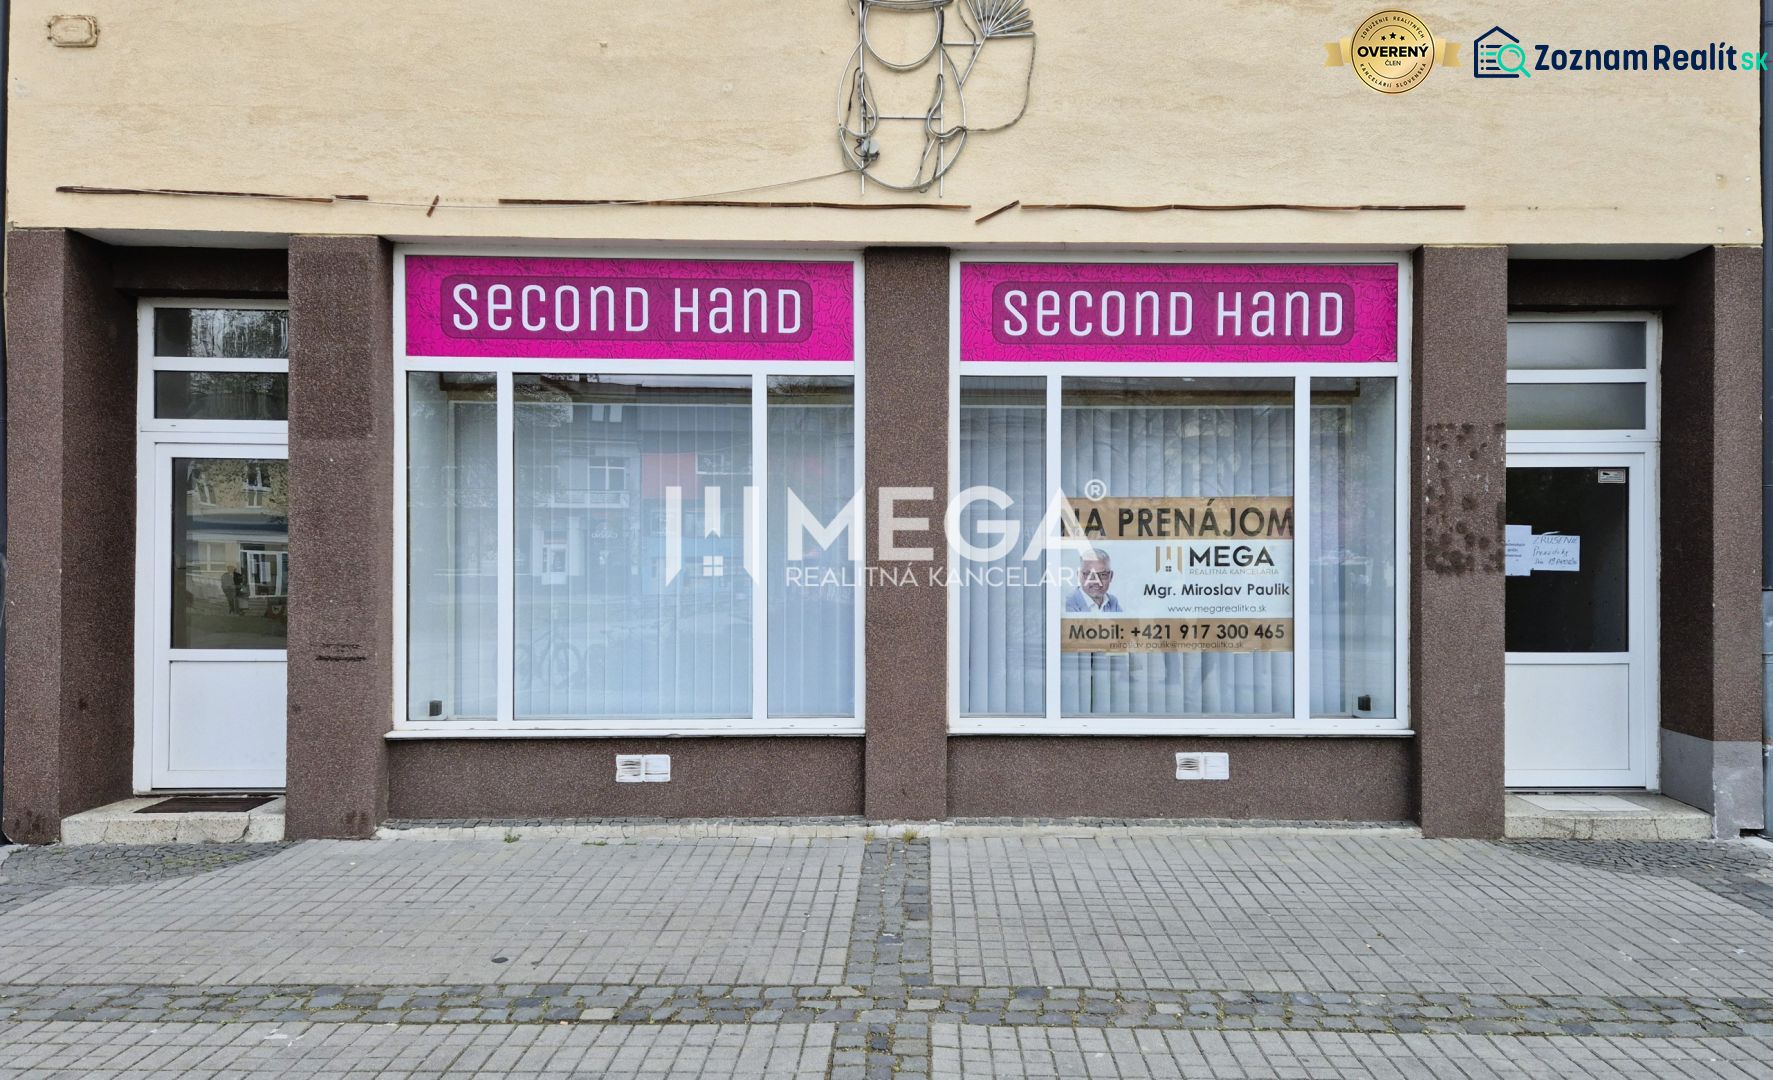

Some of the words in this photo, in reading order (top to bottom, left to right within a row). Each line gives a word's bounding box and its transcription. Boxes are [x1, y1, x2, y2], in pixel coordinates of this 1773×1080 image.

[1060, 507, 1107, 538] NA
[1118, 498, 1294, 538] PRENÁJOM
[1189, 545, 1275, 568] MEGA
[1143, 584, 1176, 599] Mgr.
[1181, 583, 1242, 596] Miroslav
[1247, 583, 1290, 596] Paulik
[1168, 604, 1267, 614] www.megarealitka.sk
[1069, 625, 1125, 640] Mobil:
[1130, 625, 1171, 640] +421
[1180, 624, 1211, 640] 917
[1216, 624, 1249, 640] 300
[1254, 624, 1285, 639] 465
